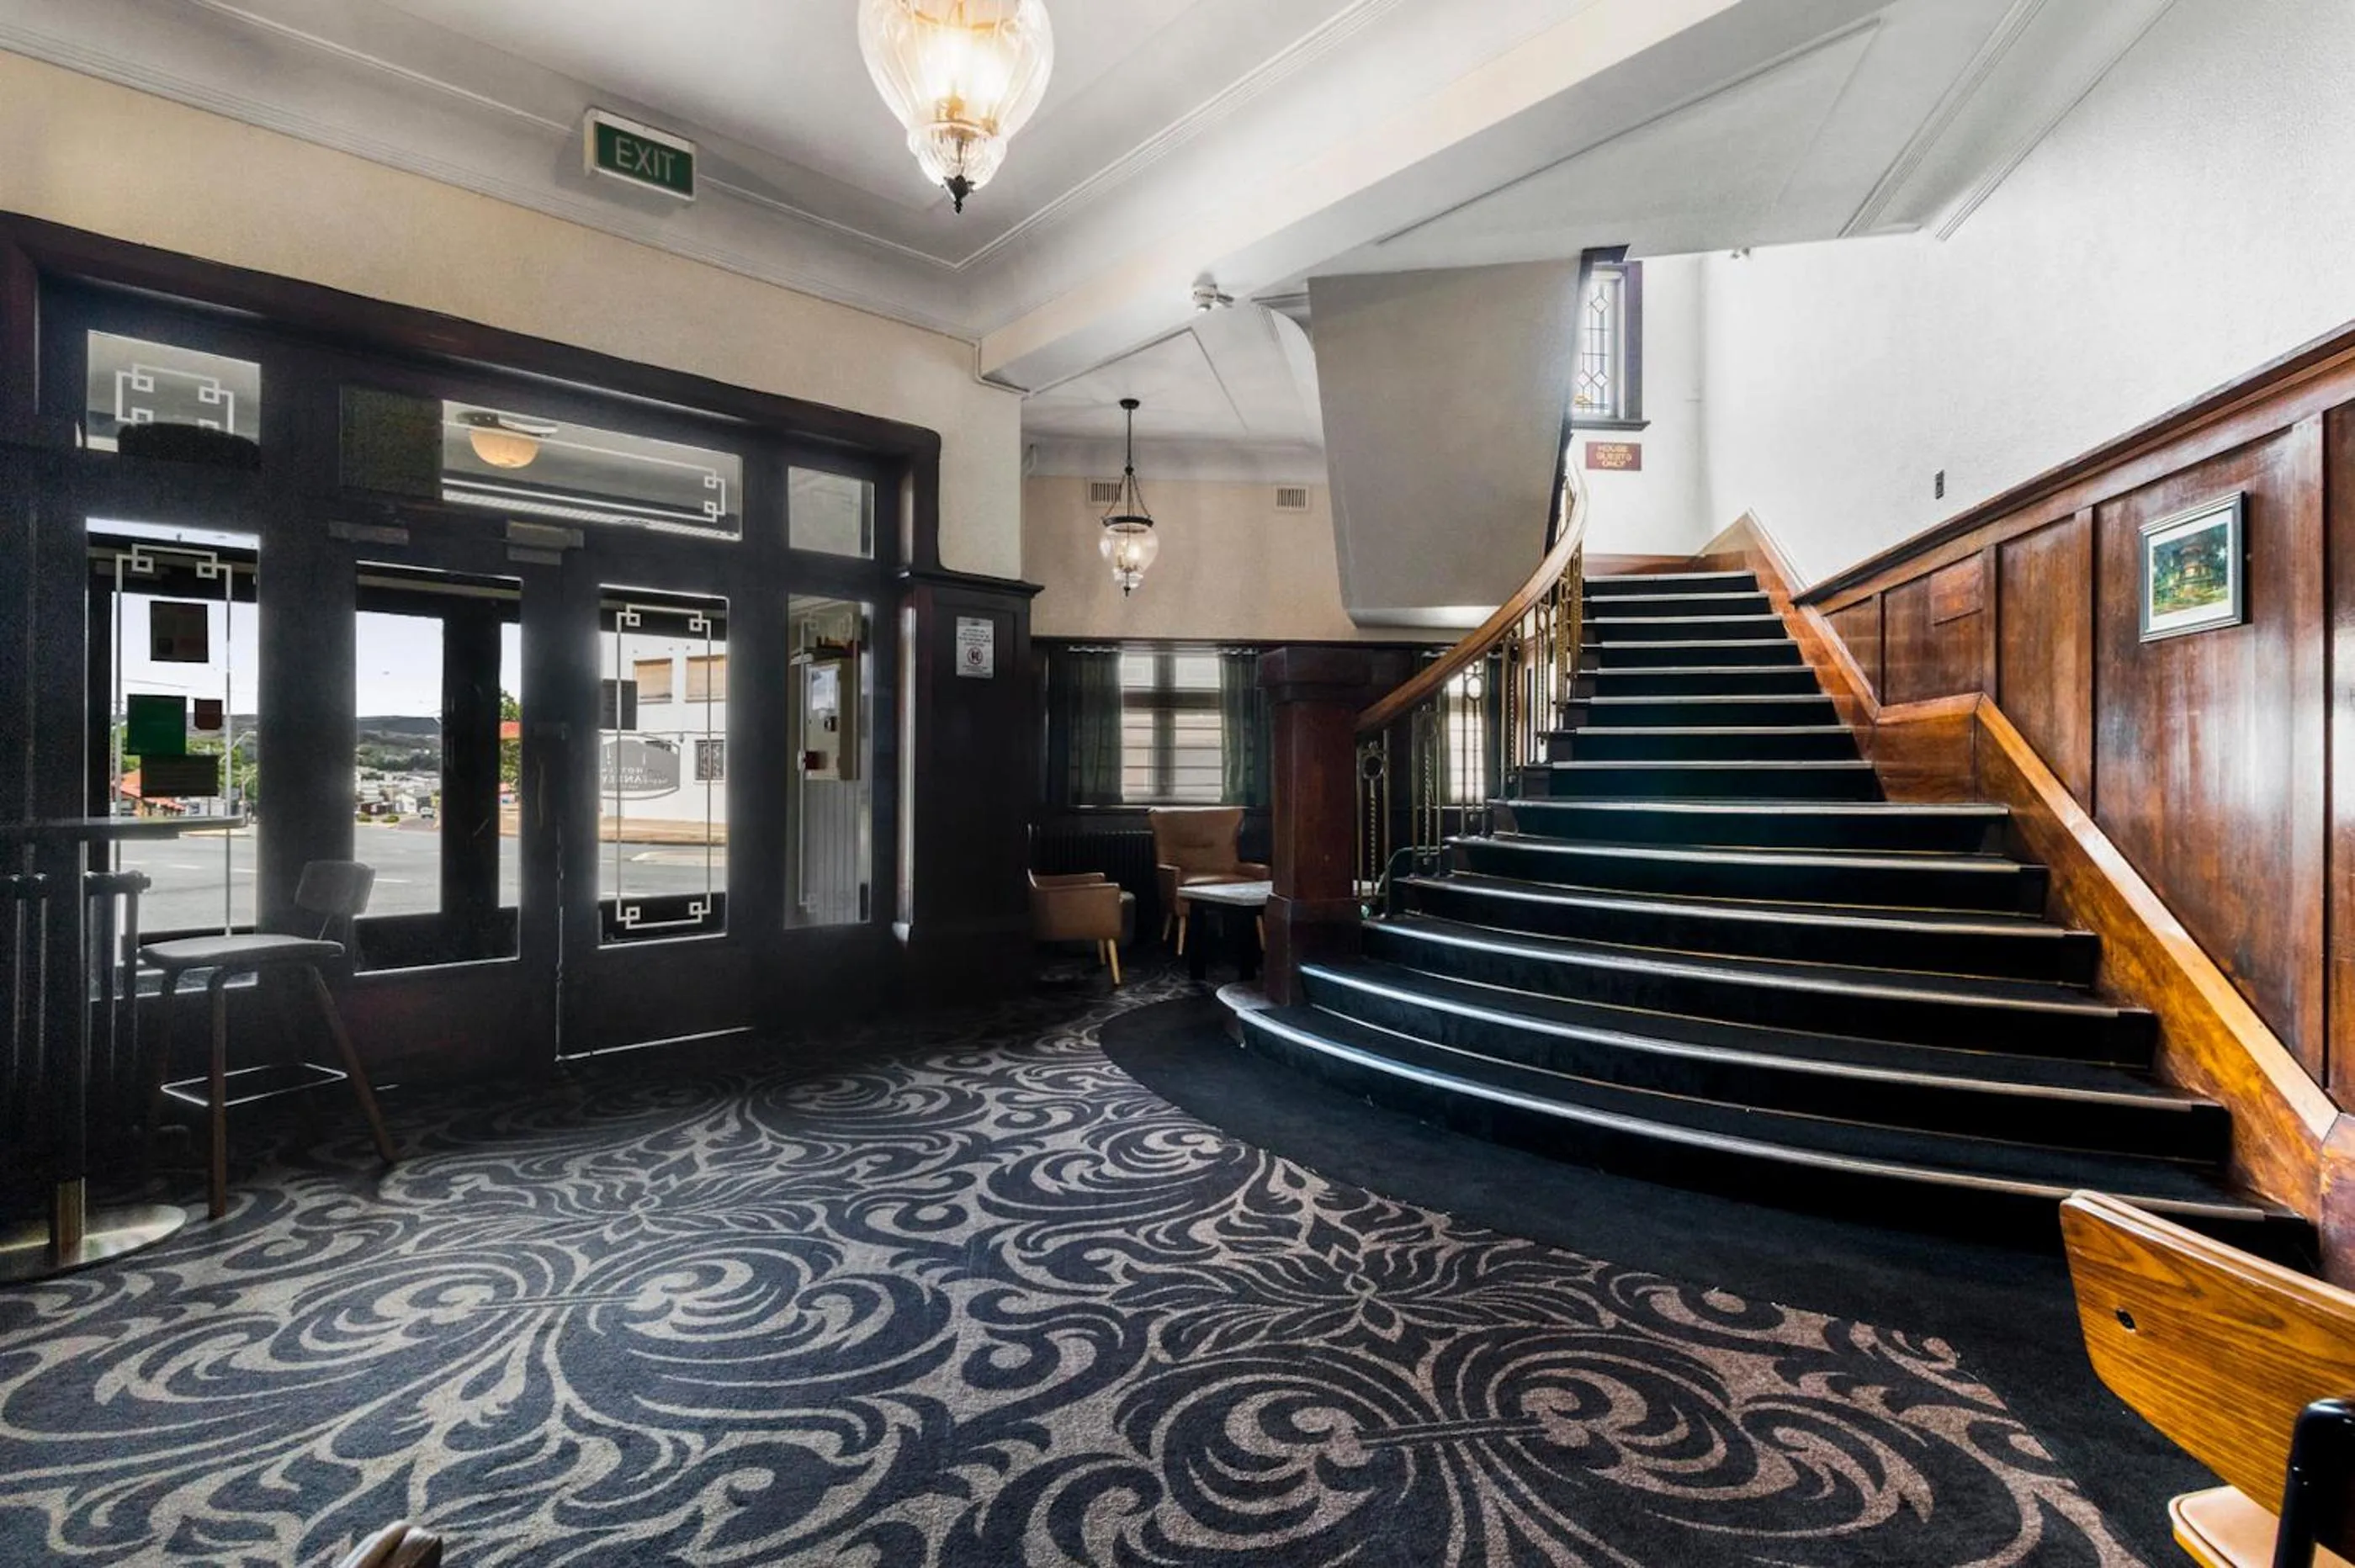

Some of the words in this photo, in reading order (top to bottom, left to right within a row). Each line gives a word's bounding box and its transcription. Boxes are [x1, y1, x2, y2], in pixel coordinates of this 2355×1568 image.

[615, 135, 676, 183] EXIT
[1597, 444, 1629, 453] HOUSE
[1595, 452, 1632, 461] GUESTS
